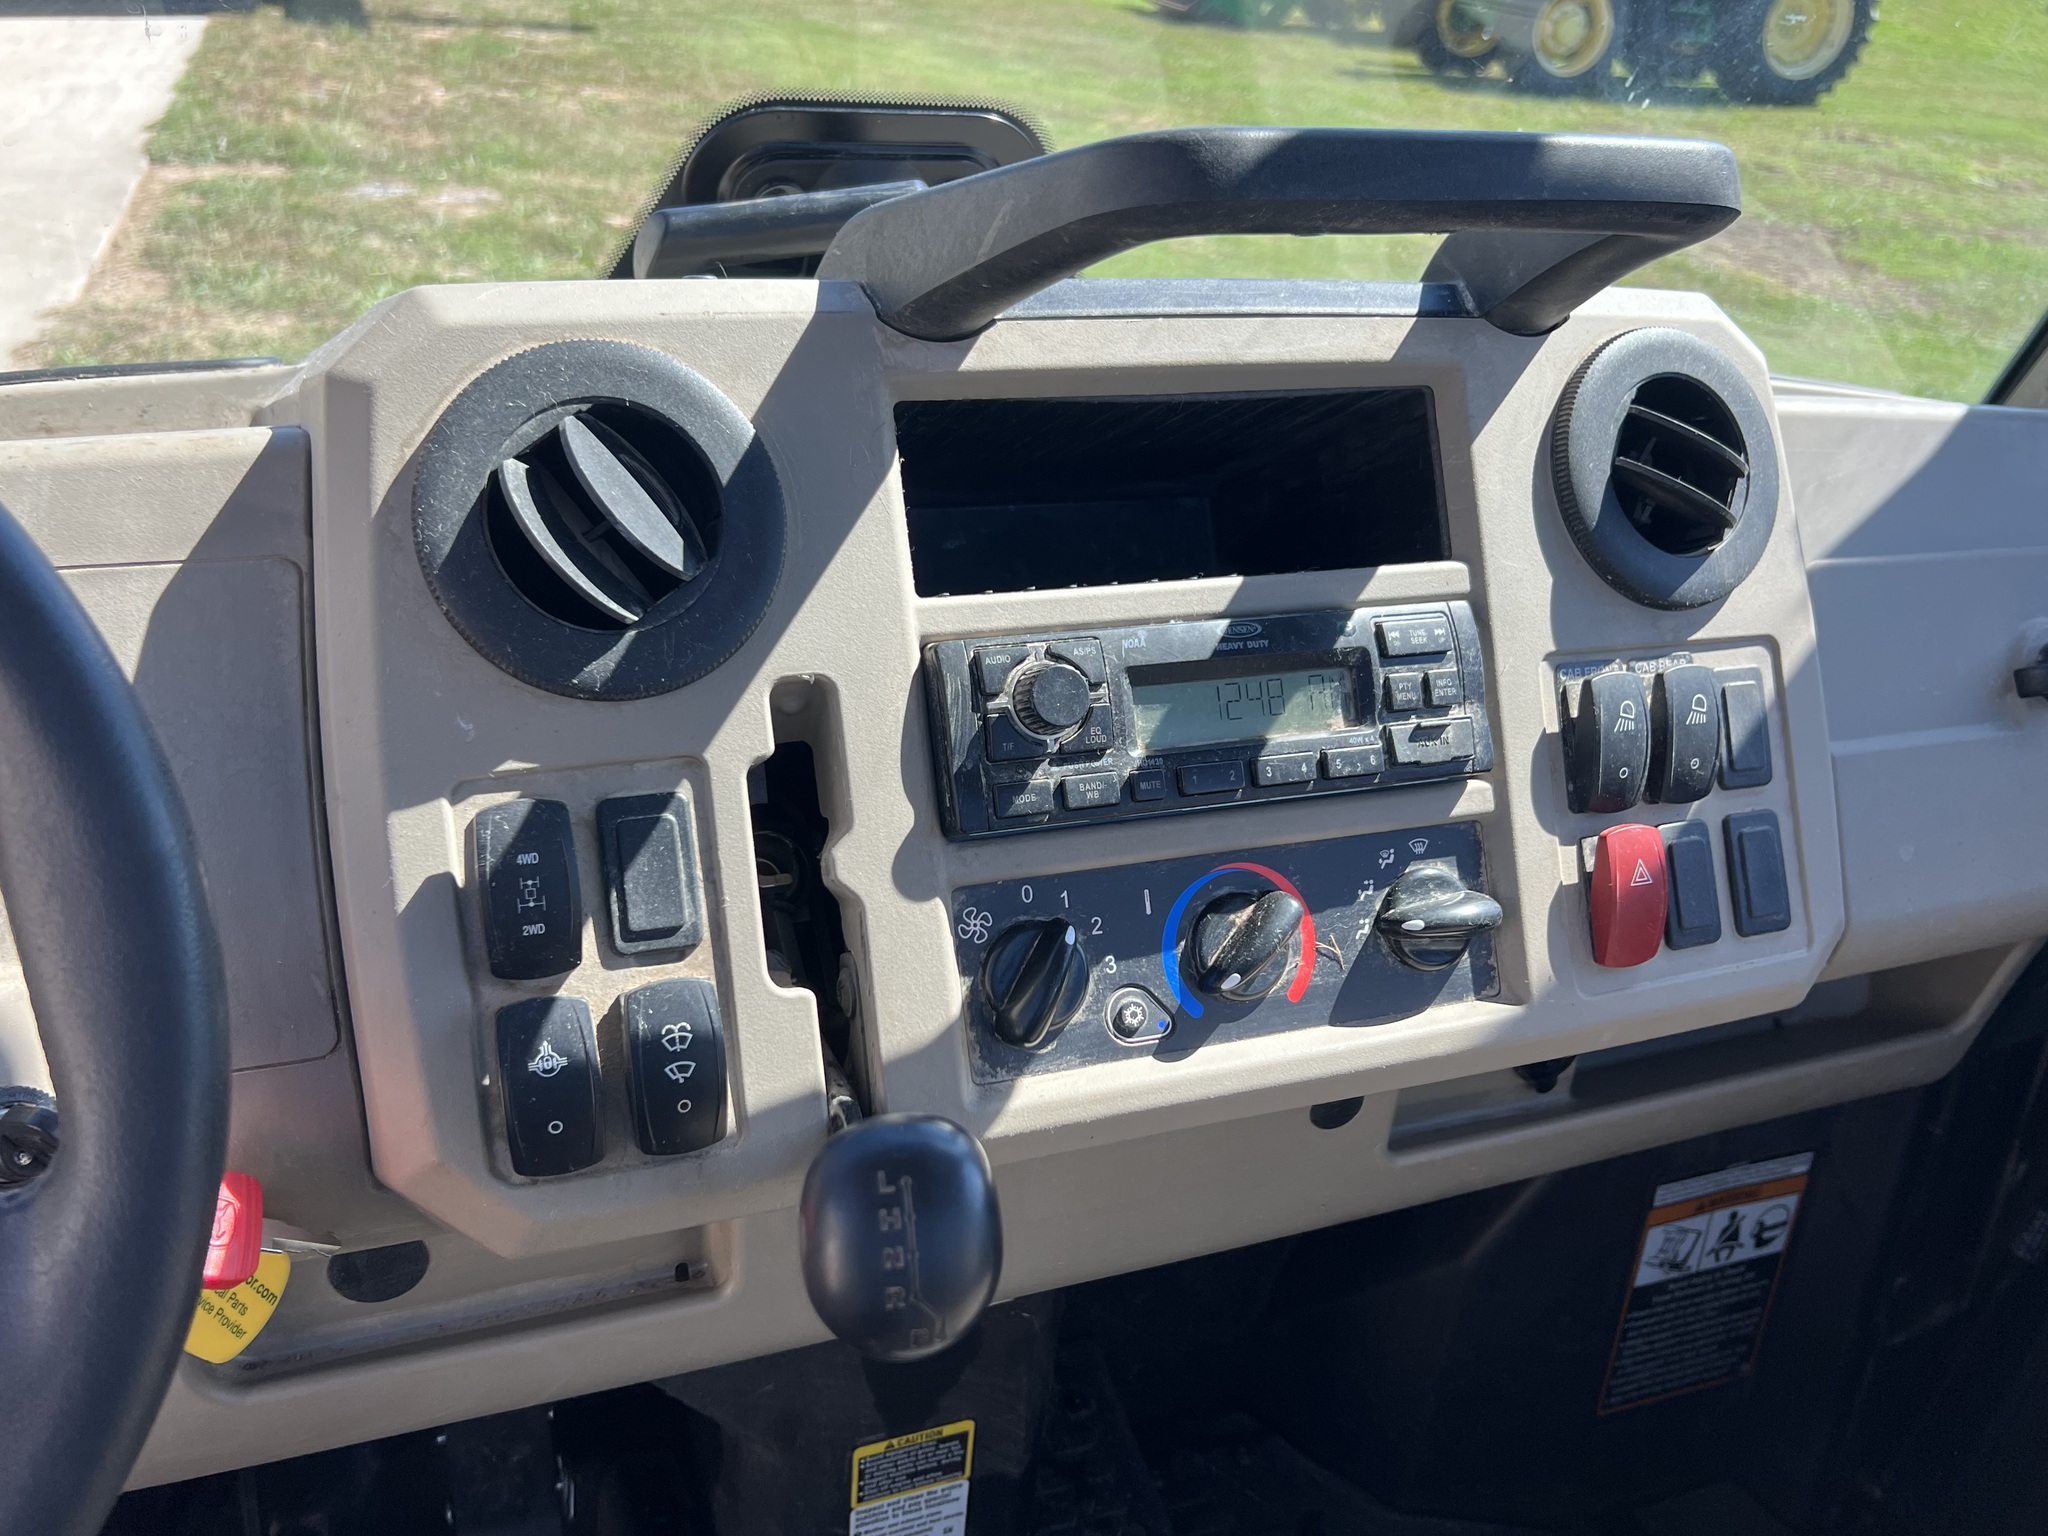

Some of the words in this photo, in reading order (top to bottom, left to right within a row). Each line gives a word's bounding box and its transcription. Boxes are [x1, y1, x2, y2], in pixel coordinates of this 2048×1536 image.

[1122, 638, 1147, 649] NOAA
[1216, 641, 1244, 651] HEAVY
[1247, 640, 1269, 649] DUTY
[1410, 636, 1428, 645] SEEK
[1073, 646, 1097, 656] AS/PS
[985, 655, 1011, 665] AUDIO
[1635, 661, 1656, 673] CAB
[1559, 667, 1582, 680] CAB
[1398, 682, 1412, 690] PTY
[1435, 678, 1452, 687] INFO
[1396, 691, 1416, 700] MENU
[1434, 687, 1457, 697] ENTER
[1091, 726, 1102, 736] EQ
[1085, 734, 1107, 744] LOUD
[1417, 738, 1438, 748] AUX
[1440, 736, 1450, 745] IN
[1335, 759, 1342, 769] 5
[1370, 754, 1377, 766] 6
[1265, 766, 1272, 777] 3
[1301, 762, 1308, 773] 4
[1229, 770, 1236, 780] 2
[1139, 780, 1161, 790] MUTE
[1012, 793, 1036, 804] MODE
[1086, 790, 1099, 799] WB
[516, 852, 539, 865] 4WD
[1021, 884, 1034, 903] 0
[1060, 890, 1069, 908] 1
[522, 923, 545, 936] 2WD
[1091, 916, 1103, 935] 2
[1105, 955, 1117, 974] 3
[877, 1170, 896, 1194] L
[878, 1206, 902, 1232] H
[885, 1285, 906, 1311] R
[226, 1292, 249, 1316] Parts
[213, 1307, 247, 1340] Provider
[897, 1428, 945, 1447] CAUTION
